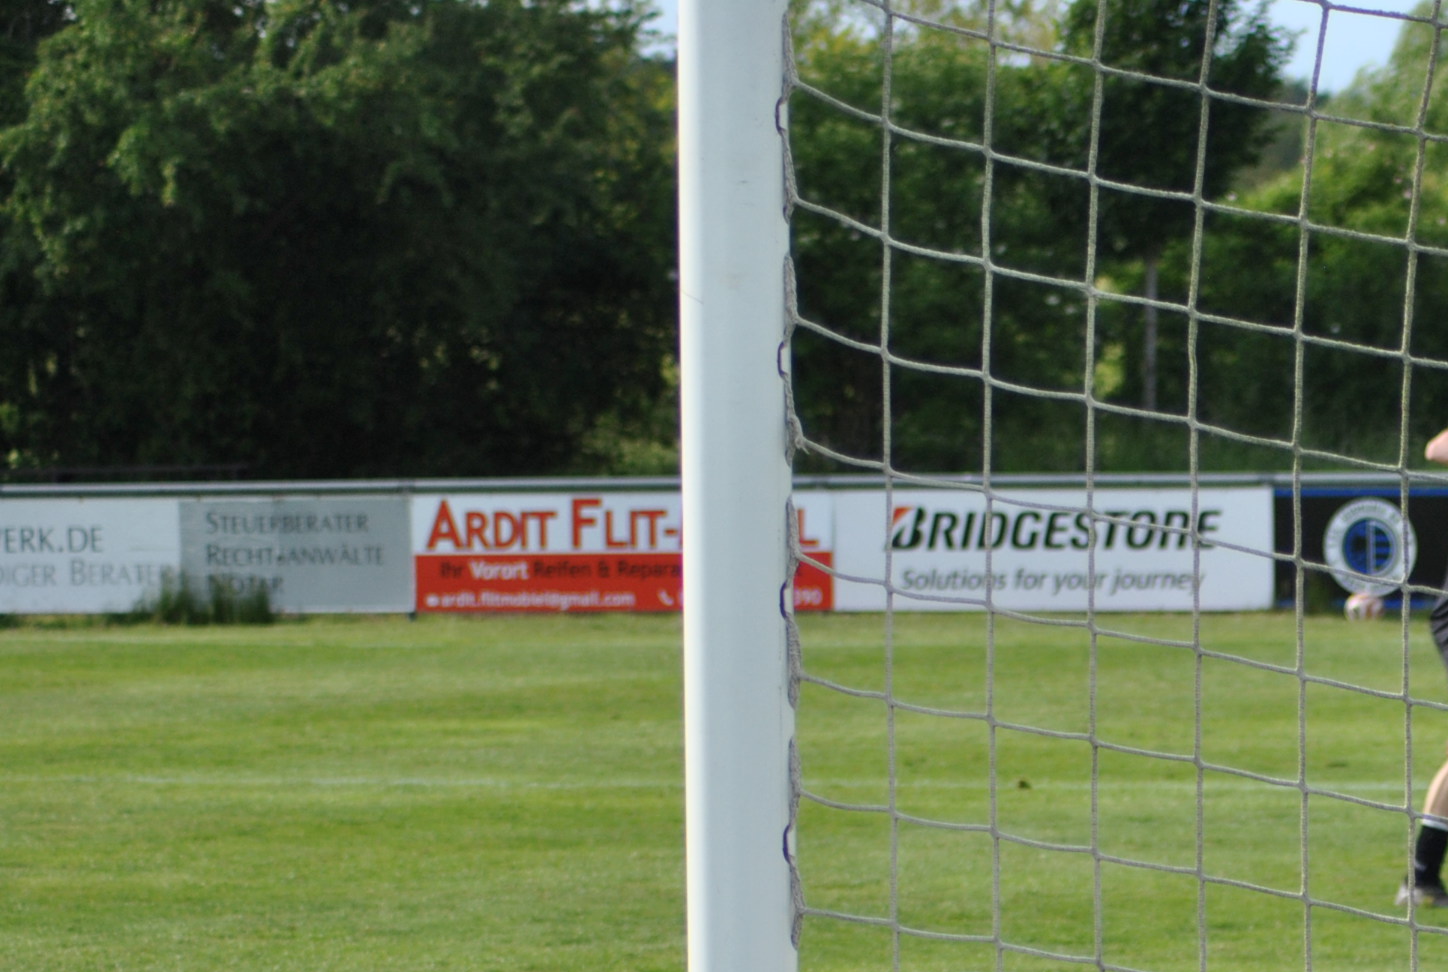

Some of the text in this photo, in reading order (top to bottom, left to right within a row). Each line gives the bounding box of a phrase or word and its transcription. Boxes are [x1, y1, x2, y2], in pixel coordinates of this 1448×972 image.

[0, 525, 105, 553] ERK.DE
[427, 499, 557, 550] ARDIT
[891, 506, 1221, 550] BRIDGESTONE
[469, 560, 528, 580] Vorort
[902, 567, 1205, 598] Solutions for your journey
